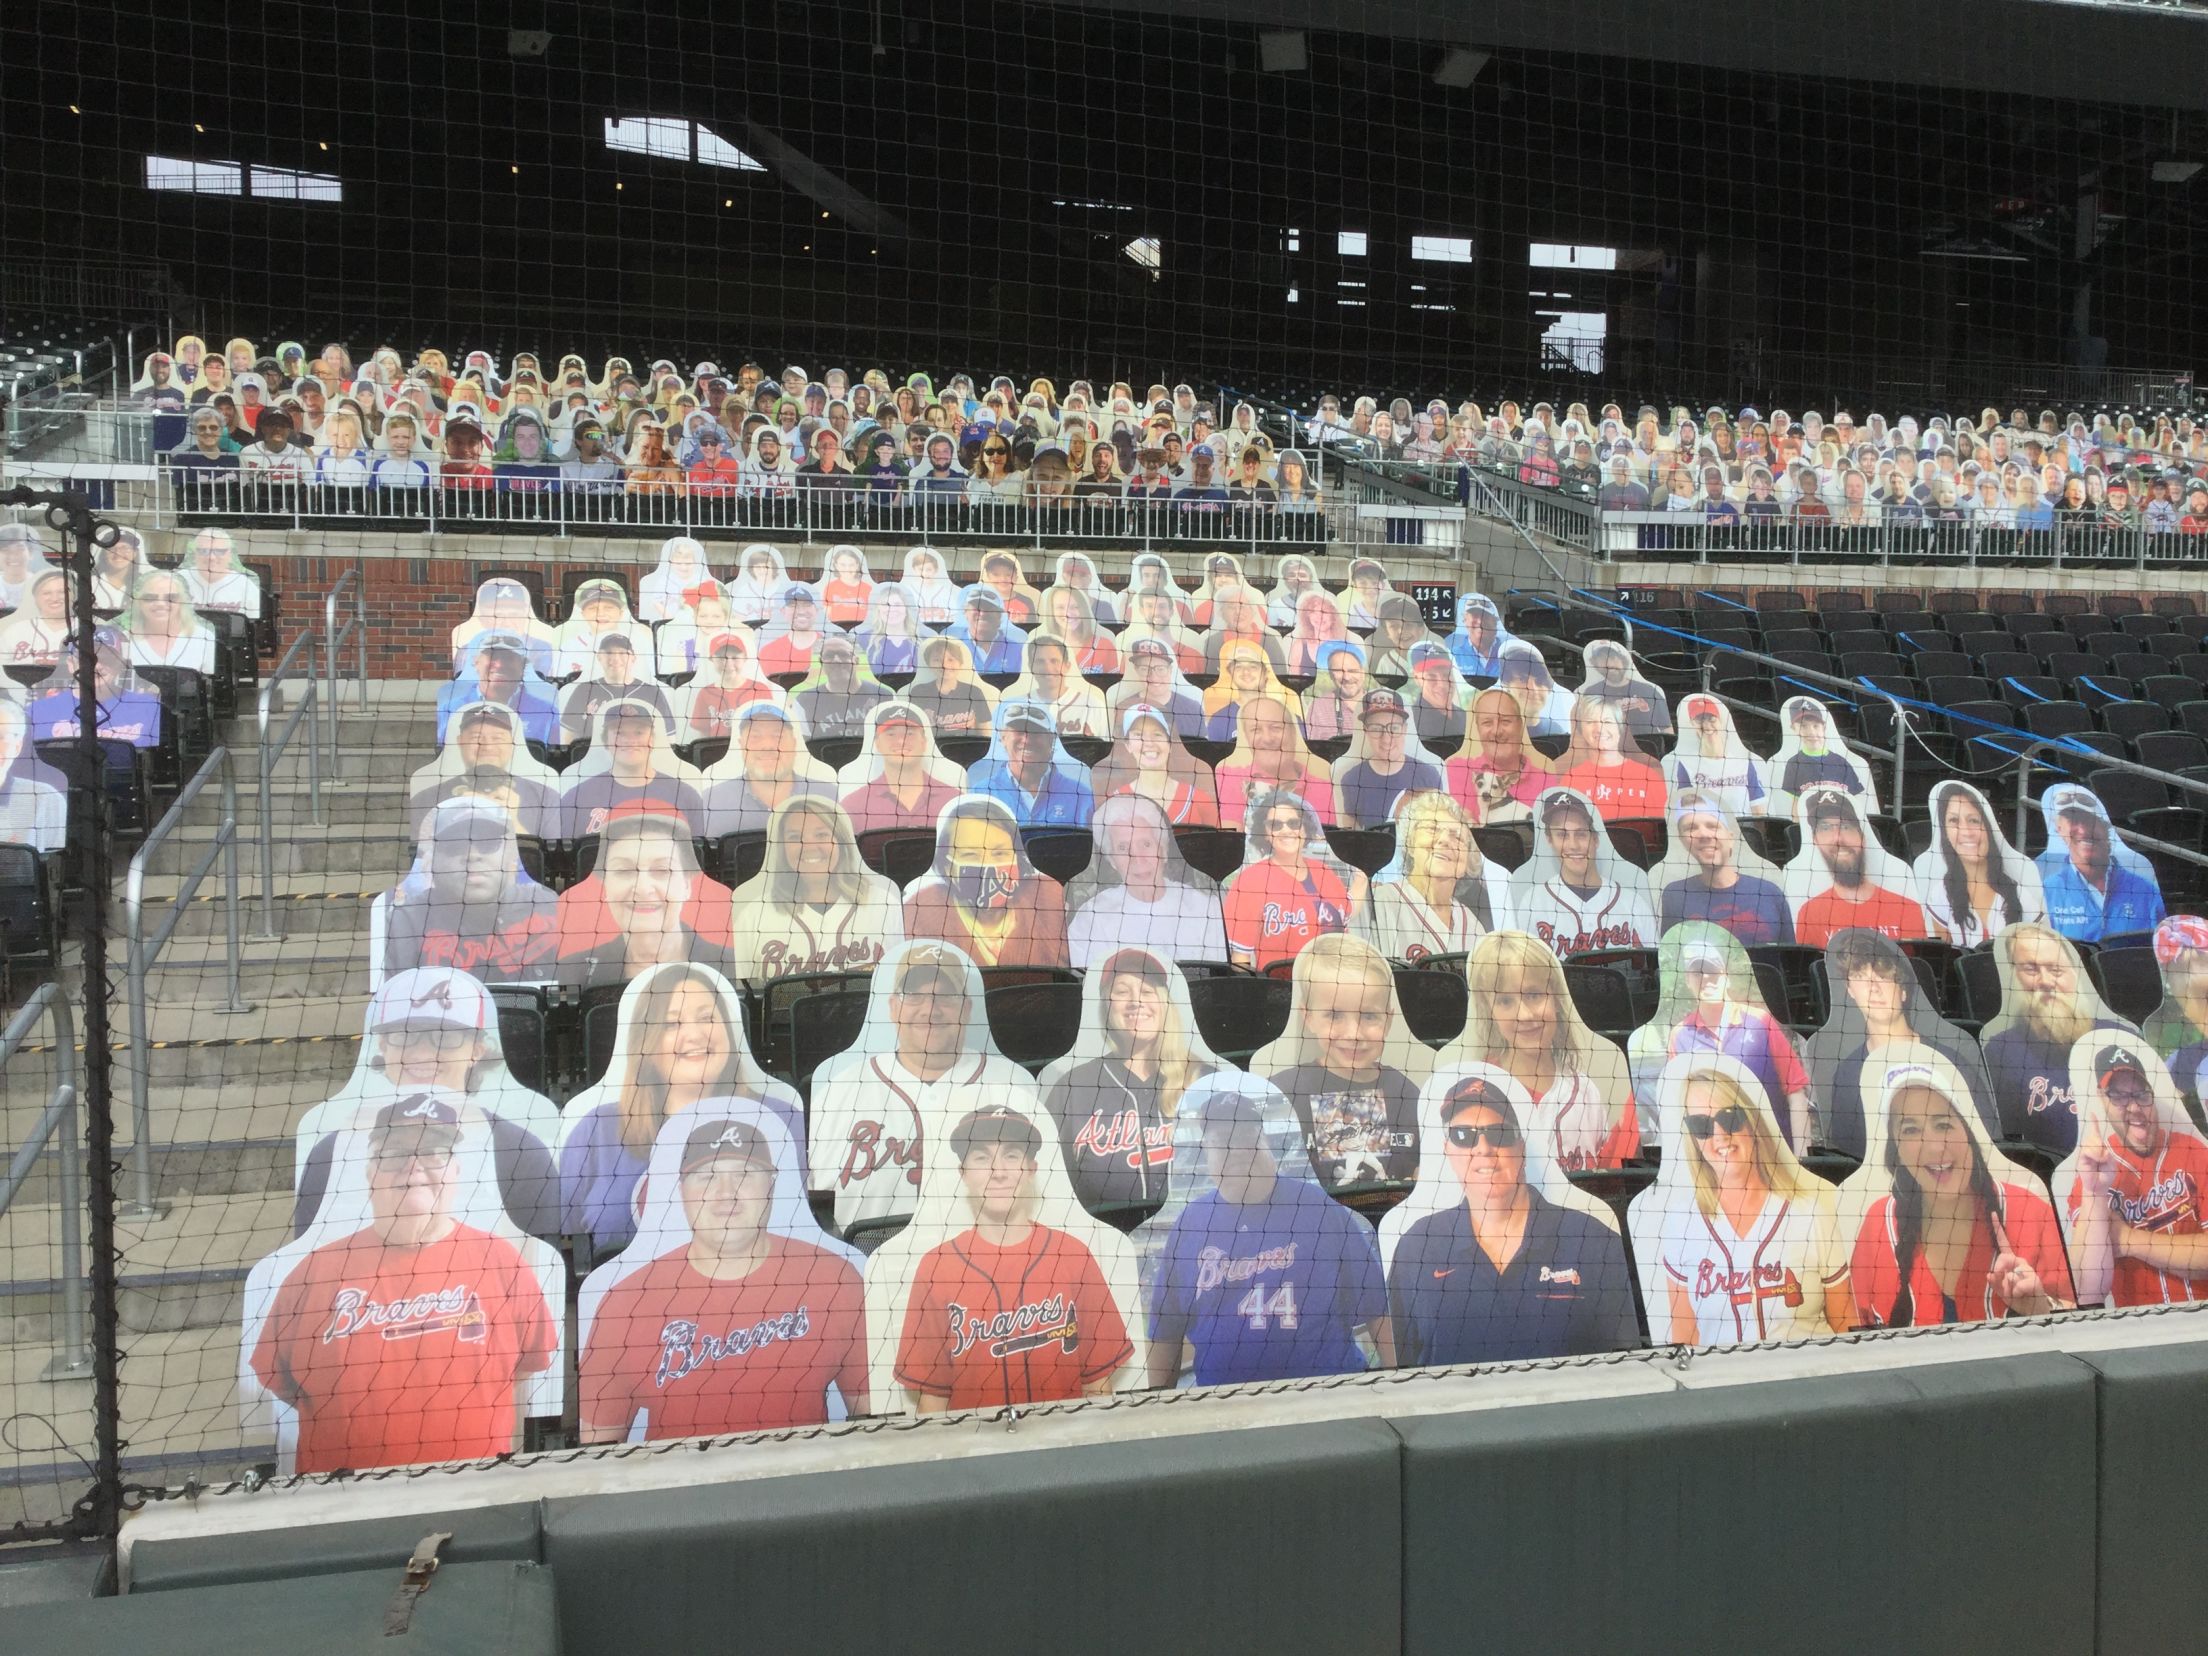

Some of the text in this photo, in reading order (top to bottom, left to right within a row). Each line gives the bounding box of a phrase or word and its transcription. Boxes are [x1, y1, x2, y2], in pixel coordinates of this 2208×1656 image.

[1416, 588, 1438, 600] 114
[819, 708, 866, 733] ATLAN
[1553, 793, 1571, 804] A
[1819, 791, 1836, 804] A
[1536, 921, 1630, 957] Braves
[411, 979, 452, 1010] A
[2109, 1048, 2130, 1064] A
[404, 1097, 438, 1118] A
[2027, 1076, 2079, 1116] Bra
[710, 1126, 743, 1149] A
[1074, 1108, 1175, 1161] Atlan
[839, 1120, 923, 1189] Bra
[1196, 1243, 1298, 1300] Braves
[1695, 1258, 1783, 1302] Braves
[324, 1284, 467, 1344] Braves
[1237, 1282, 1298, 1329] 44
[947, 1293, 1063, 1358] Braves
[656, 1306, 809, 1387] Braves
